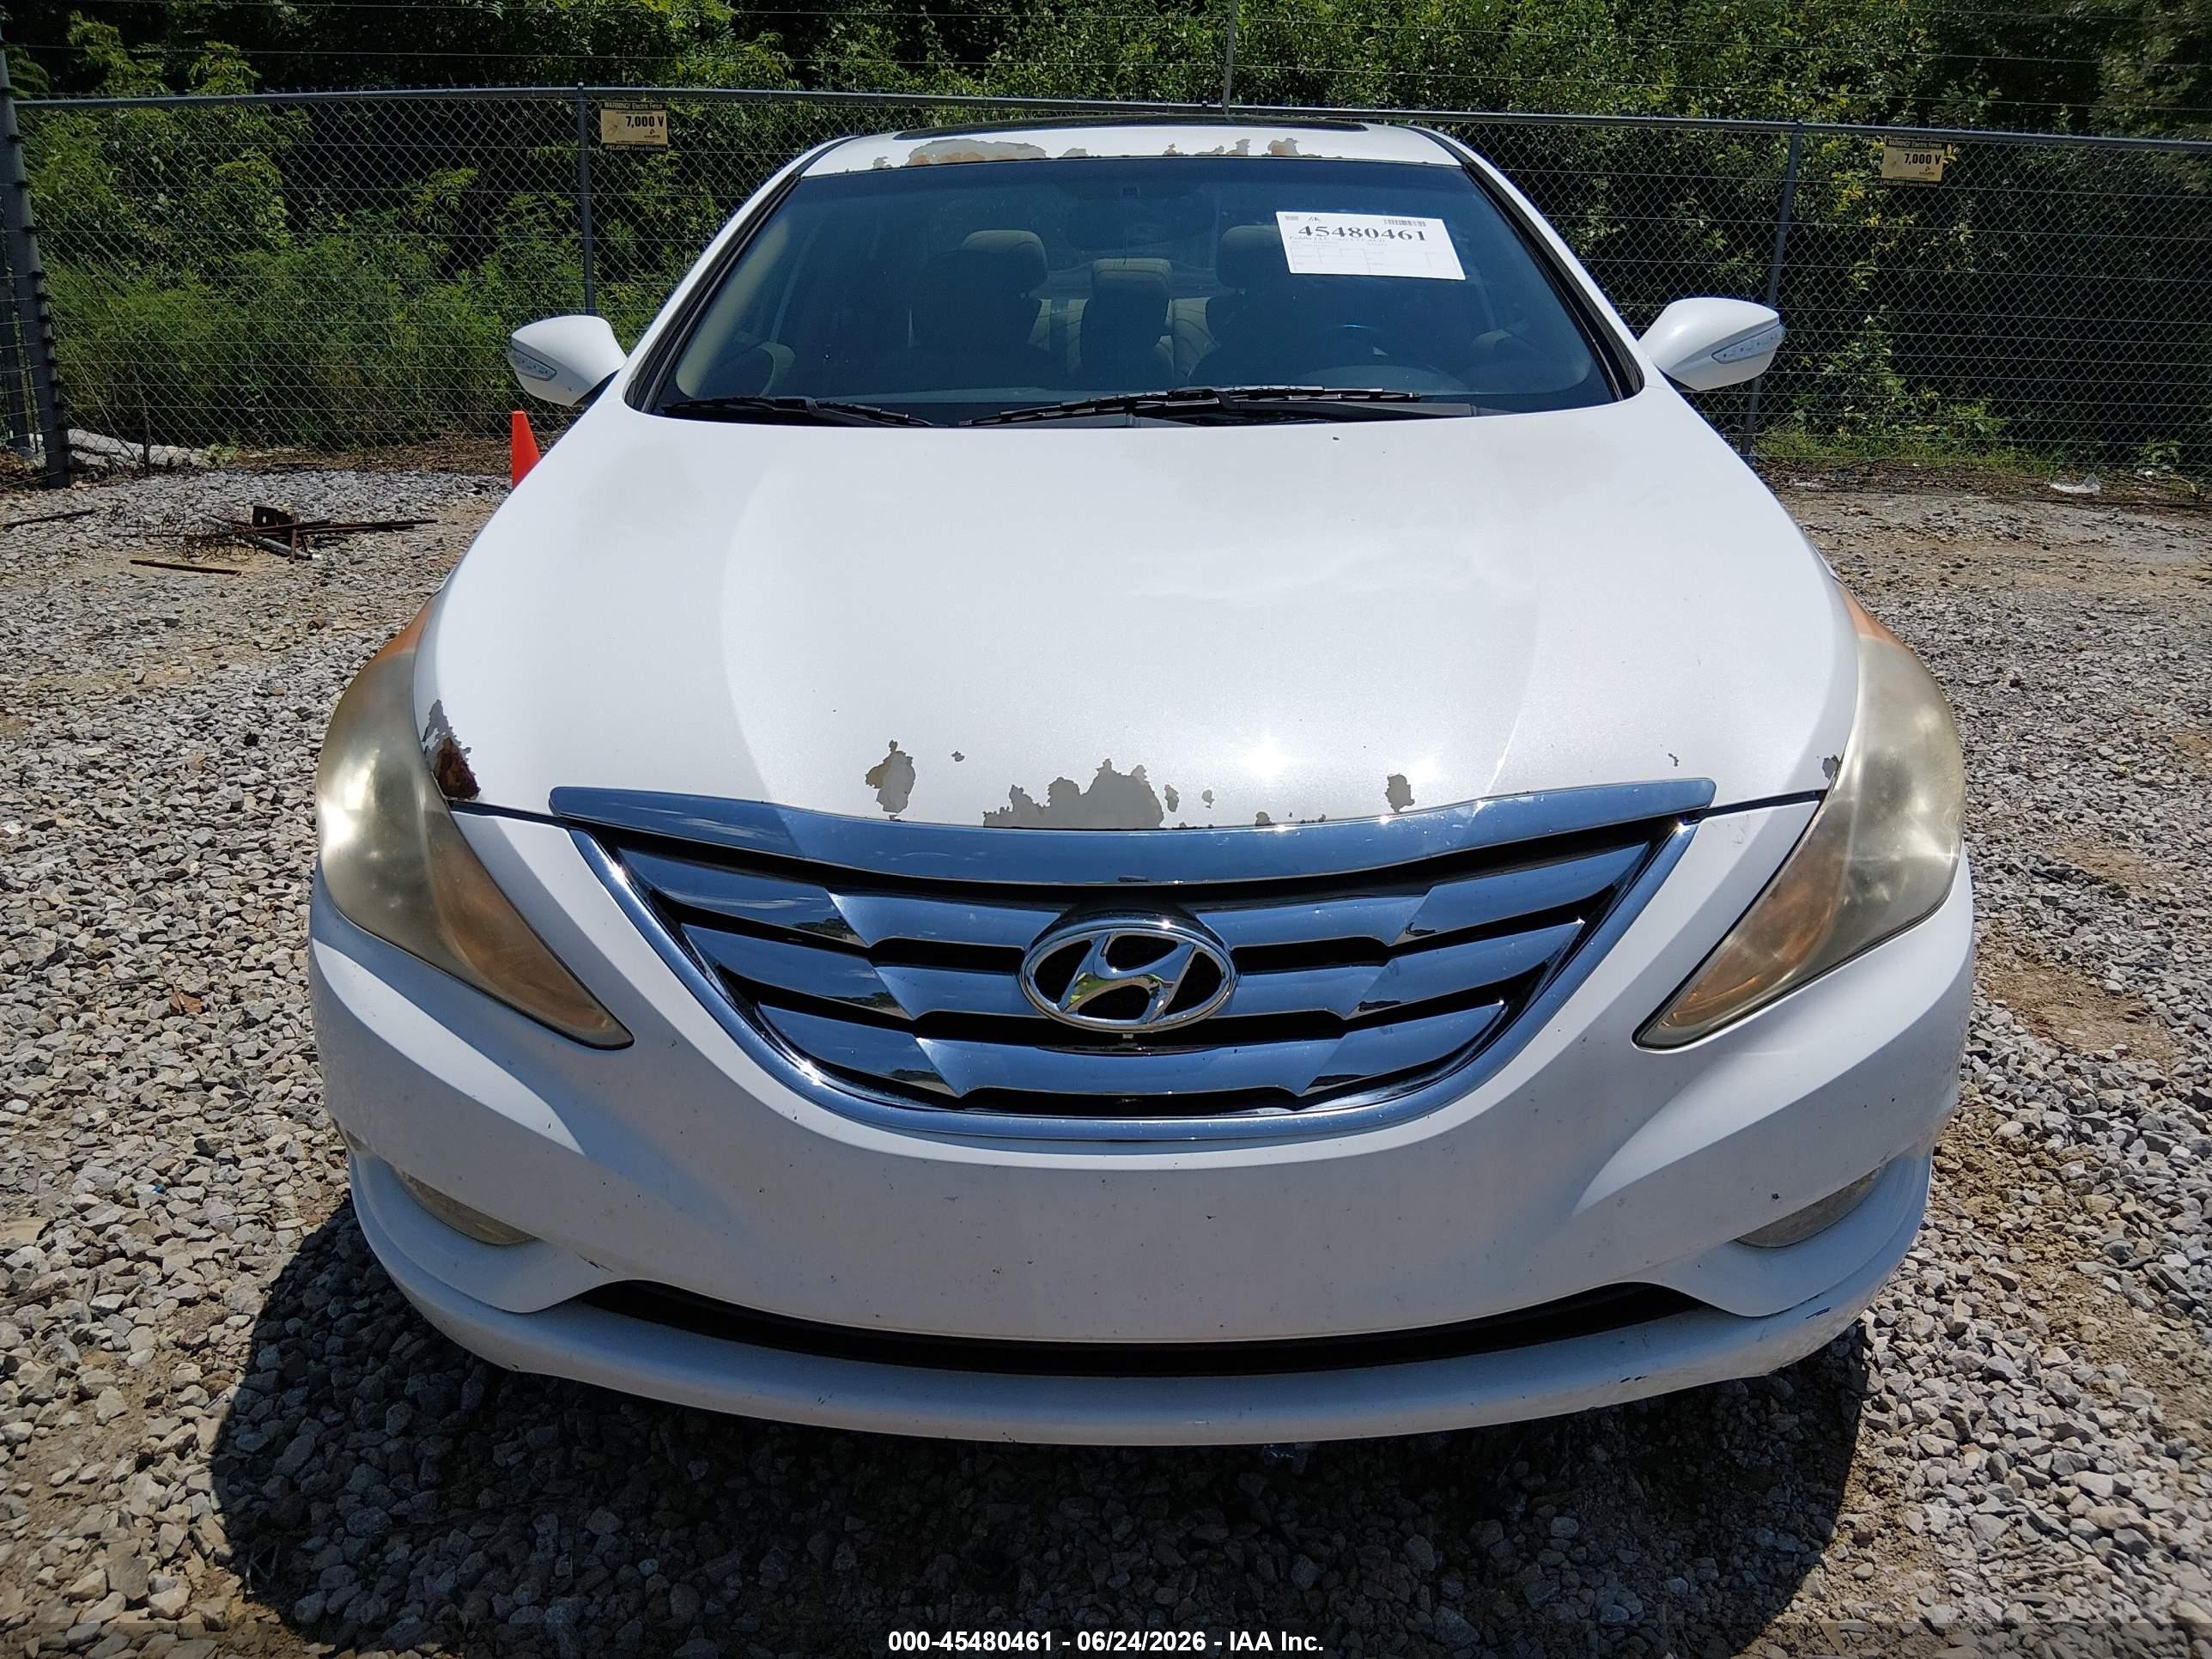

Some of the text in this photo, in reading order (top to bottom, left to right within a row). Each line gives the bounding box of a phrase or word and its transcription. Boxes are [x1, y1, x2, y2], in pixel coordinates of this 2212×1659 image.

[626, 116, 665, 128] 7,000 V
[1904, 153, 1942, 165] 7,000 V
[1297, 226, 1427, 241] 45480461
